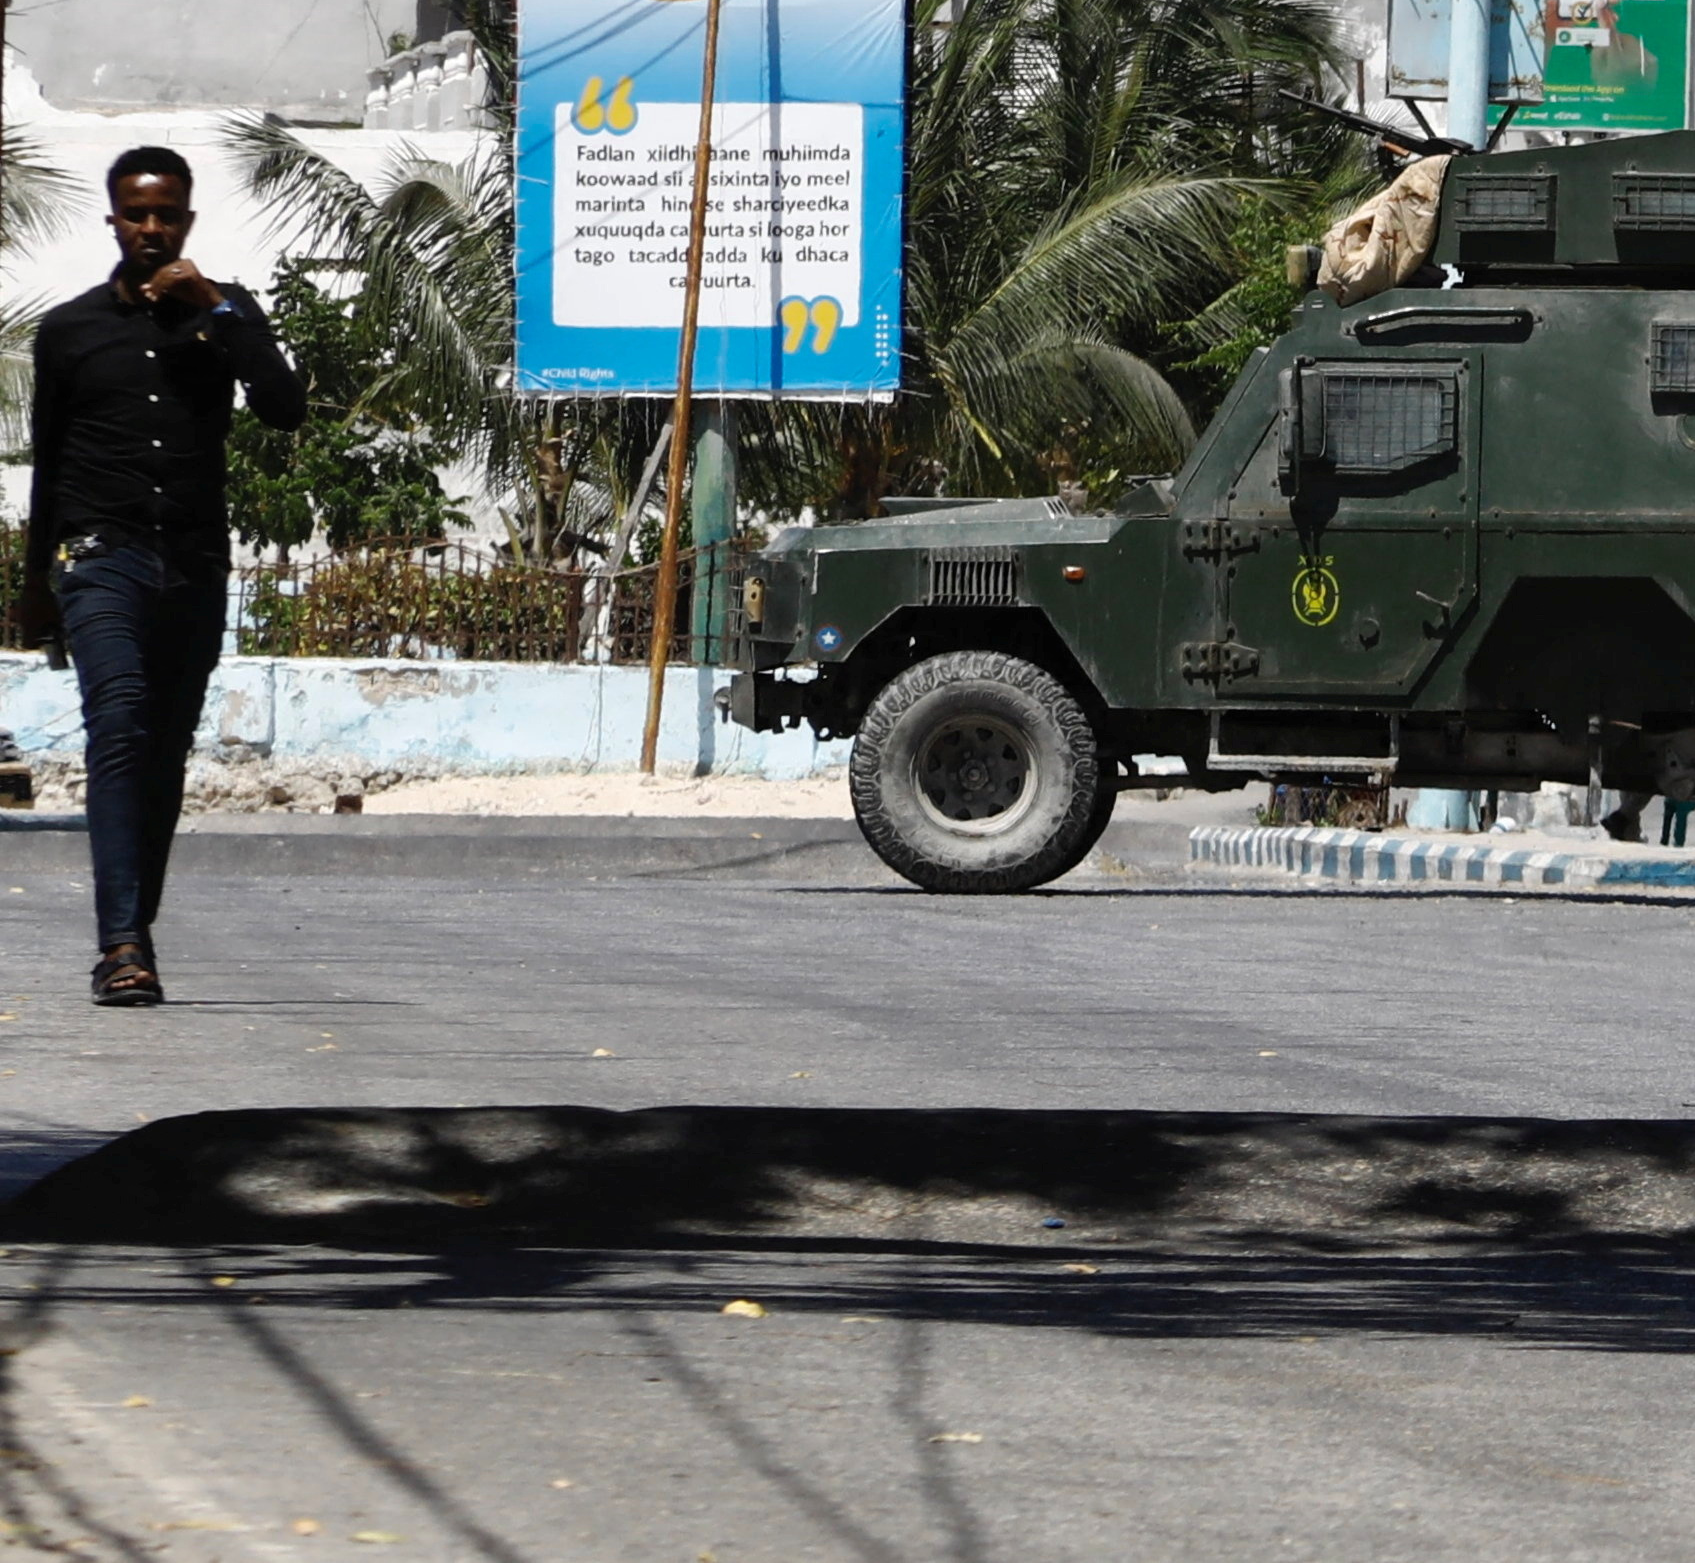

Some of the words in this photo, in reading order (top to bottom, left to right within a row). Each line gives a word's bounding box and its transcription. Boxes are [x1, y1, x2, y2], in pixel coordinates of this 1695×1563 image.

[577, 144, 635, 162] Fadlan
[646, 144, 751, 162] xildhiaane
[763, 143, 850, 161] muhiimda
[576, 169, 658, 187] koowaad
[688, 170, 769, 187] asixinta
[774, 170, 801, 192] iyo
[807, 169, 850, 186] meel
[575, 196, 645, 213] marinta
[733, 195, 849, 215] sharciyeedka
[574, 220, 665, 241] xuquuqda
[749, 220, 762, 237] si
[768, 220, 815, 242] looga
[819, 220, 850, 237] hor
[574, 248, 614, 266] tago
[761, 246, 783, 263] ku
[795, 246, 849, 263] dhaca
[541, 367, 577, 379] #Child
[579, 367, 614, 381] Rights
